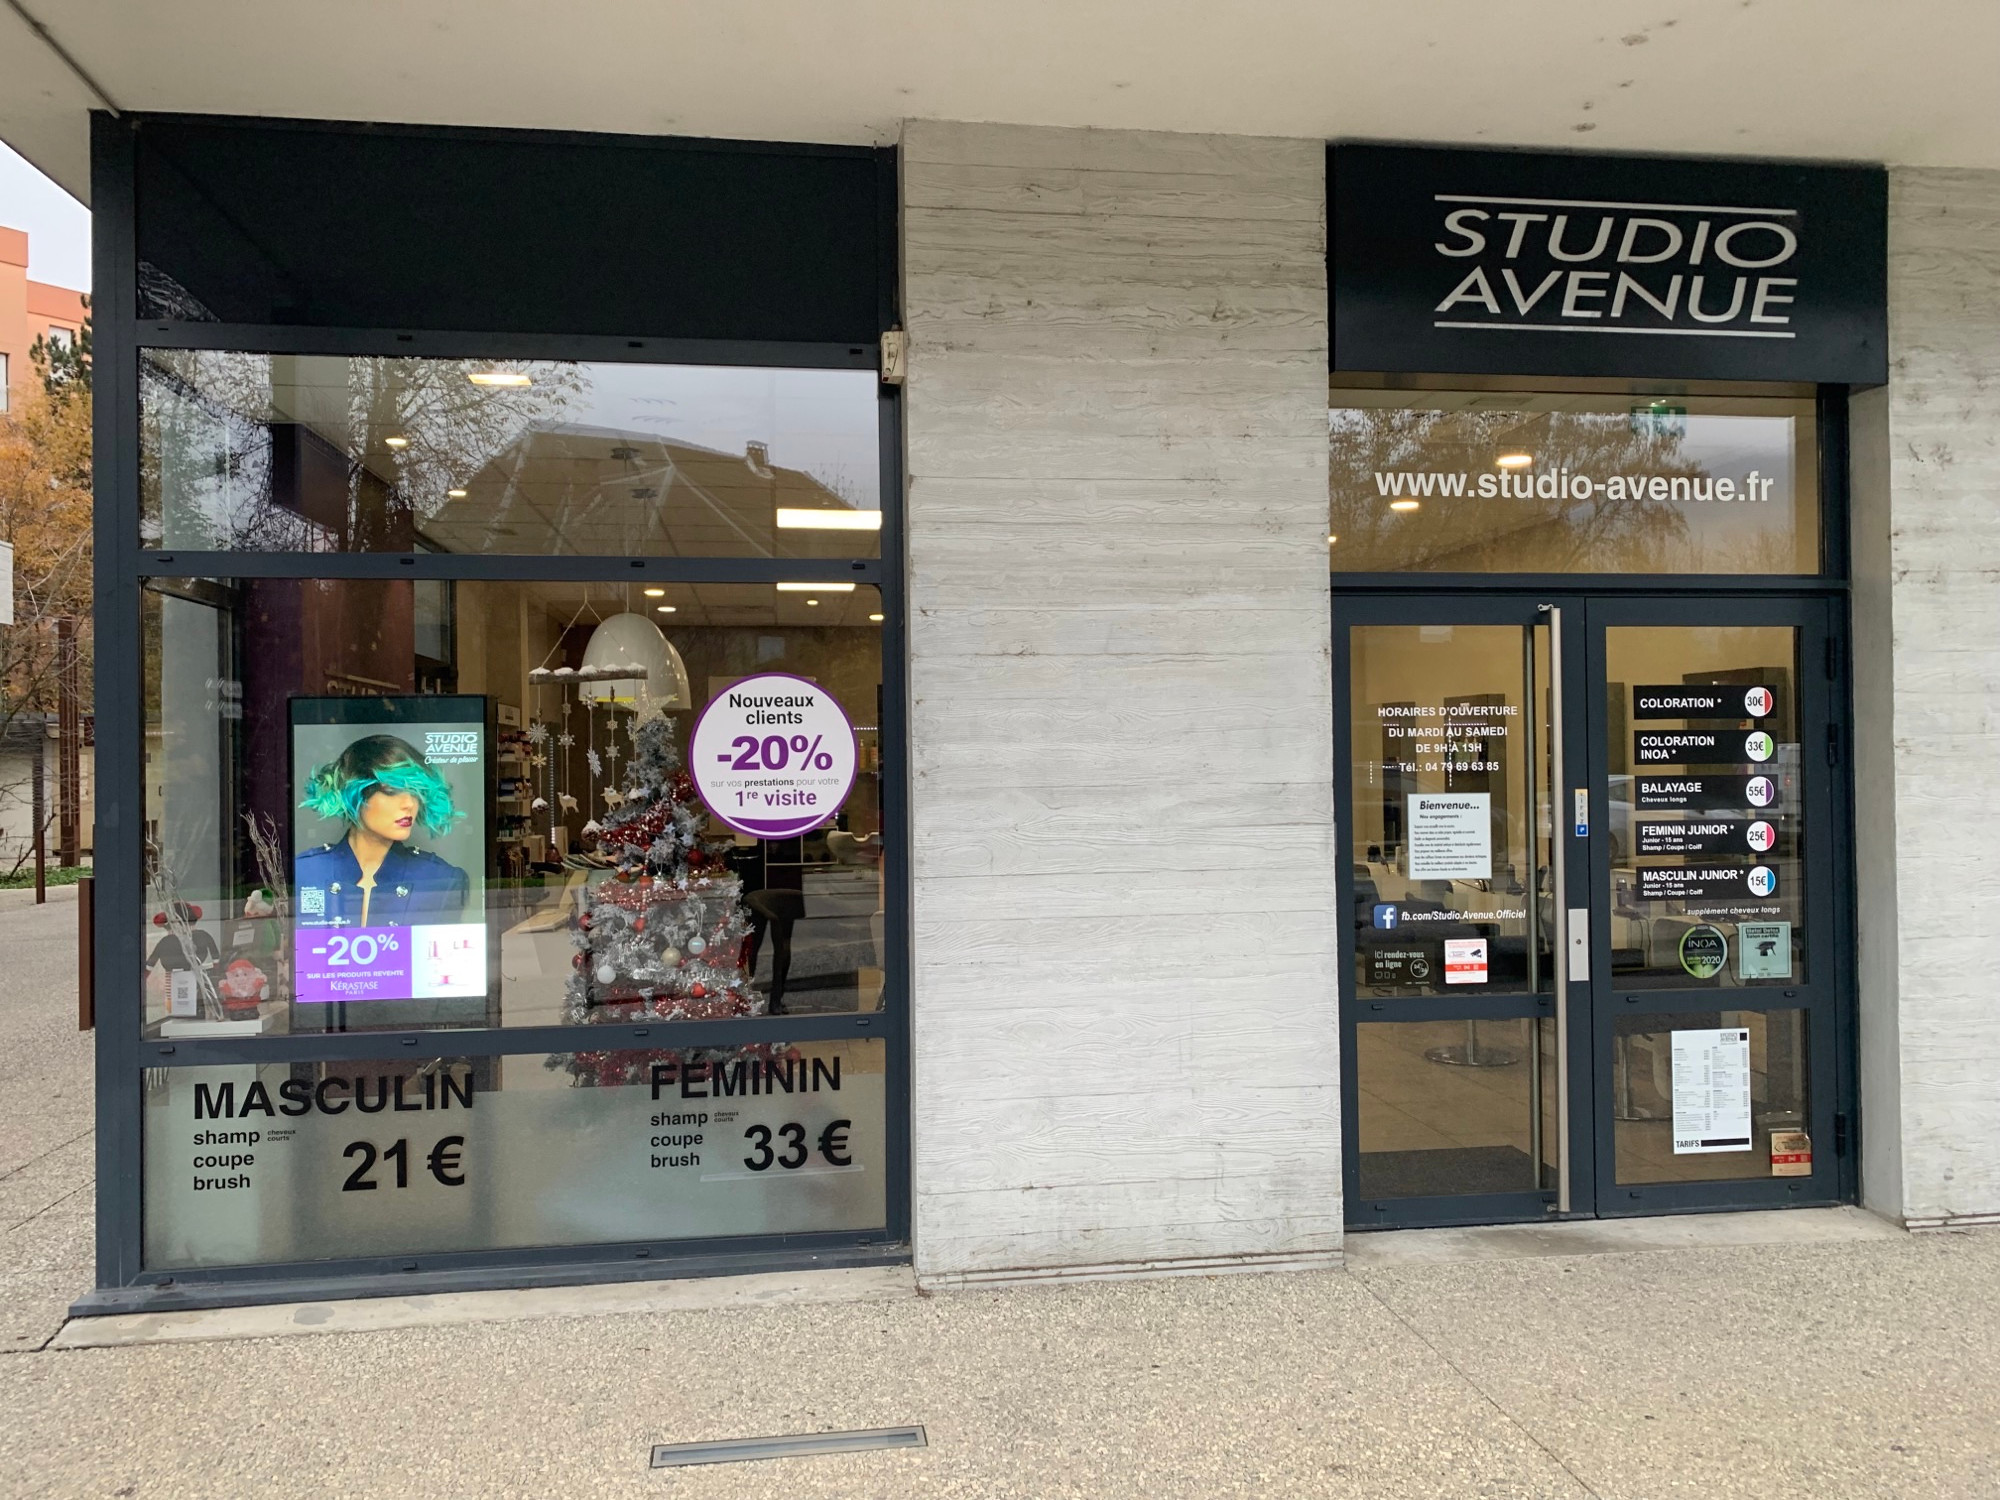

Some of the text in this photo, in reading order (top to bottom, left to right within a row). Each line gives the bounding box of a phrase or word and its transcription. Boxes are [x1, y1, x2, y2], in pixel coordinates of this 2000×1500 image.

[1434, 209, 1798, 269] STUDIO
[1434, 265, 1798, 324] AVENUE
[1375, 467, 1775, 502] www.studio-avenue.fr
[729, 694, 814, 708] Nouveaux
[1640, 698, 1714, 708] COLORATION
[1747, 696, 1763, 707] 30€
[1378, 706, 1518, 717] HORAIRES D'OUVERTURE
[746, 710, 803, 725] clients
[1389, 726, 1508, 737] DU MARDI AU SAMEDI
[425, 734, 477, 744] STUDIO
[1641, 736, 1714, 746] COLORATION
[425, 743, 477, 753] AVENUE
[1415, 743, 1431, 753] DE
[1434, 743, 1448, 753] 9H
[1451, 741, 1459, 753] À
[1747, 741, 1764, 751] 33€
[717, 734, 833, 771] -20%
[1641, 749, 1669, 760] INOA
[1425, 762, 1438, 772] 04
[1440, 762, 1453, 772] 79
[1456, 762, 1469, 772] 69
[1471, 762, 1484, 772] 63
[1486, 761, 1499, 771] 85
[744, 778, 794, 789] prestations
[796, 779, 815, 788] pour
[819, 778, 839, 786] votre
[1641, 782, 1702, 793] BALAYAGE
[1748, 786, 1765, 796] 55€
[764, 789, 817, 806] visite
[1669, 796, 1687, 804] longs
[1420, 801, 1480, 810] Bienvenue...
[1642, 825, 1728, 836] FEMININ JUNIOR
[1749, 831, 1765, 841] 25€
[1643, 870, 1738, 881] MASCULIN JUNIOR
[1750, 876, 1766, 886] 15€
[1401, 909, 1527, 921] fb.com/Studio.Avenue.Officiel
[1687, 908, 1728, 916] supplément
[1761, 906, 1780, 914] longs
[312, 933, 399, 966] -20%
[1384, 950, 1425, 959] rendez-vous
[1375, 960, 1402, 970] en ligne
[1701, 956, 1721, 965] 2020
[337, 970, 371, 978] PRODUITS
[373, 969, 404, 977] REVENTE
[194, 1073, 474, 1120] MASCULIN
[650, 1112, 708, 1127] shamp
[193, 1129, 260, 1147] shamp
[650, 1132, 703, 1149] coupe
[744, 1119, 852, 1171] 33 €
[1676, 1140, 1700, 1148] TARIFS
[193, 1153, 255, 1170] coupe
[342, 1135, 465, 1192] 21 €
[651, 1152, 700, 1168] brush
[193, 1174, 251, 1191] brush
